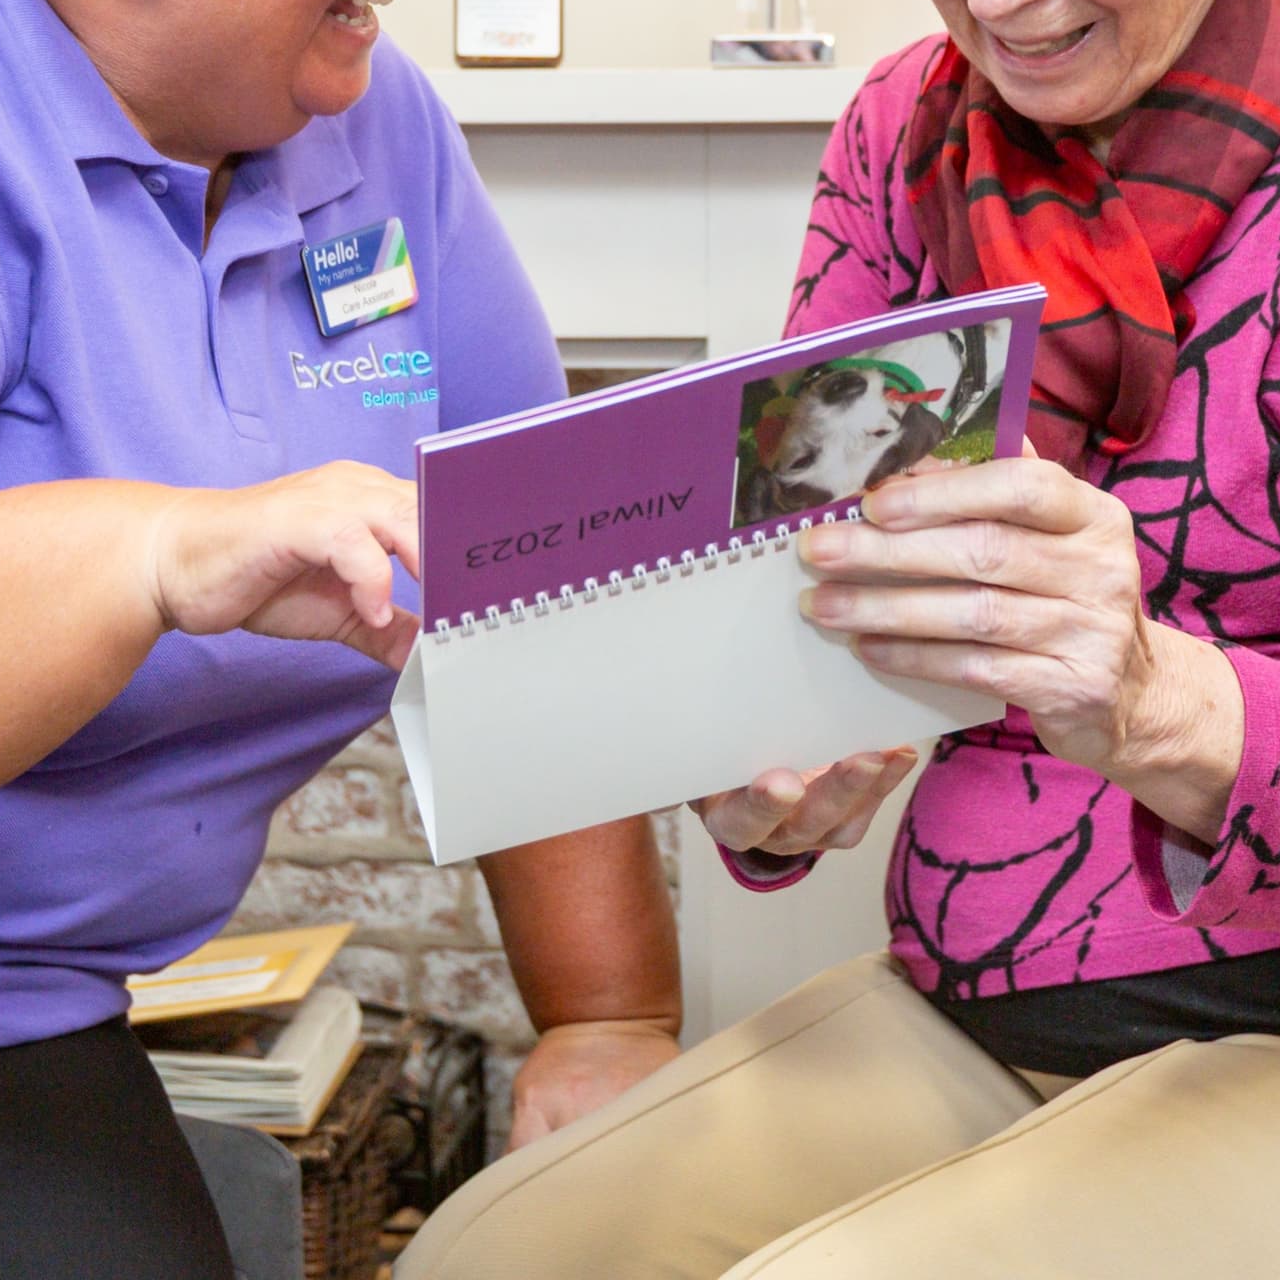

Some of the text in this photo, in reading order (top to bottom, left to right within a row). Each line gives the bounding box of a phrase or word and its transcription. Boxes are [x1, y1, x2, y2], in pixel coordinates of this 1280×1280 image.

[312, 237, 360, 272] Hello!
[317, 274, 332, 286] My
[331, 267, 355, 282] name
[342, 301, 362, 314] Care
[465, 484, 695, 572] Aliwal 2023
